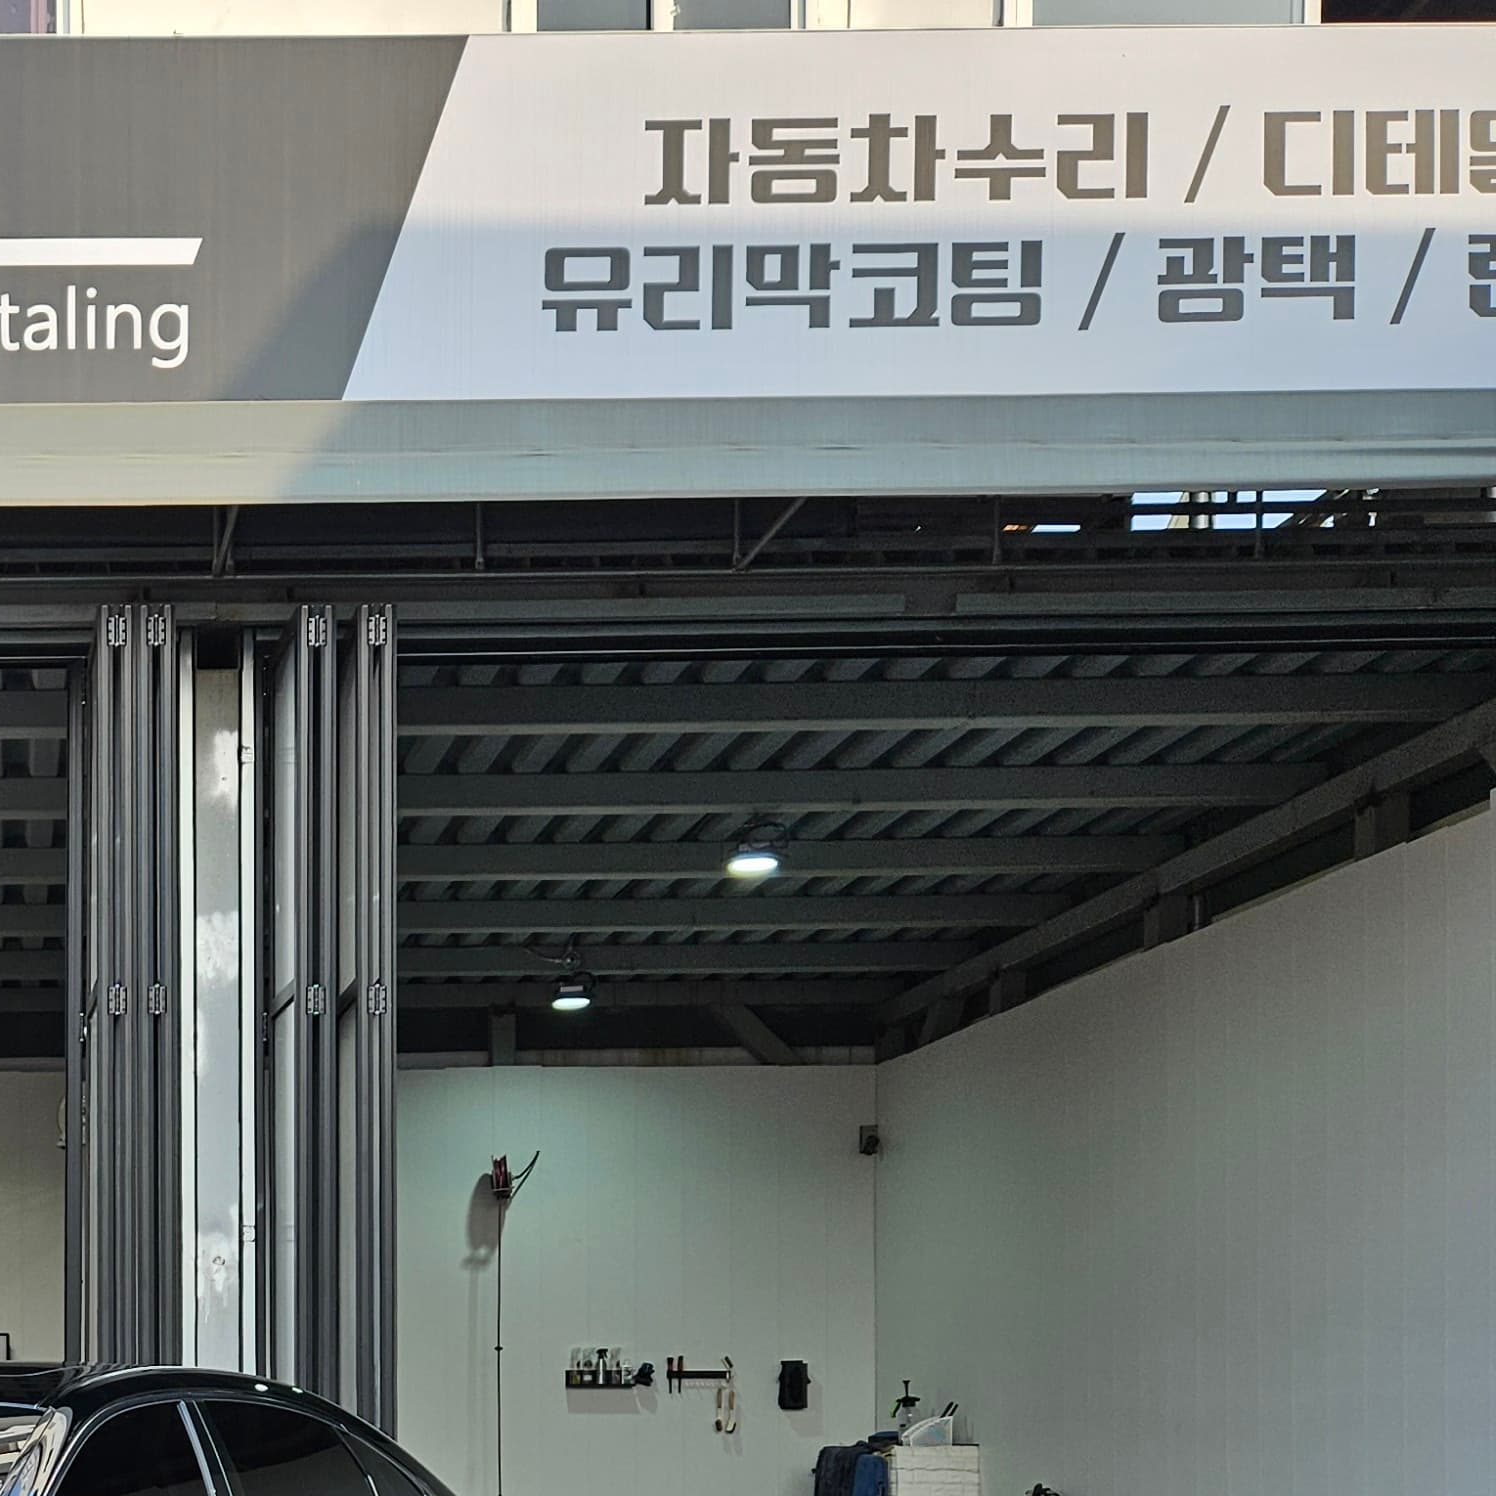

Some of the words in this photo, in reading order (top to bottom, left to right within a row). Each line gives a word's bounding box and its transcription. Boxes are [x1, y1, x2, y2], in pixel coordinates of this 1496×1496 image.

[644, 109, 1150, 206] 자동차수리
[1261, 108, 1496, 196] 디테
[541, 239, 1044, 333] 유리막코팅
[1157, 233, 1356, 324] 광택
